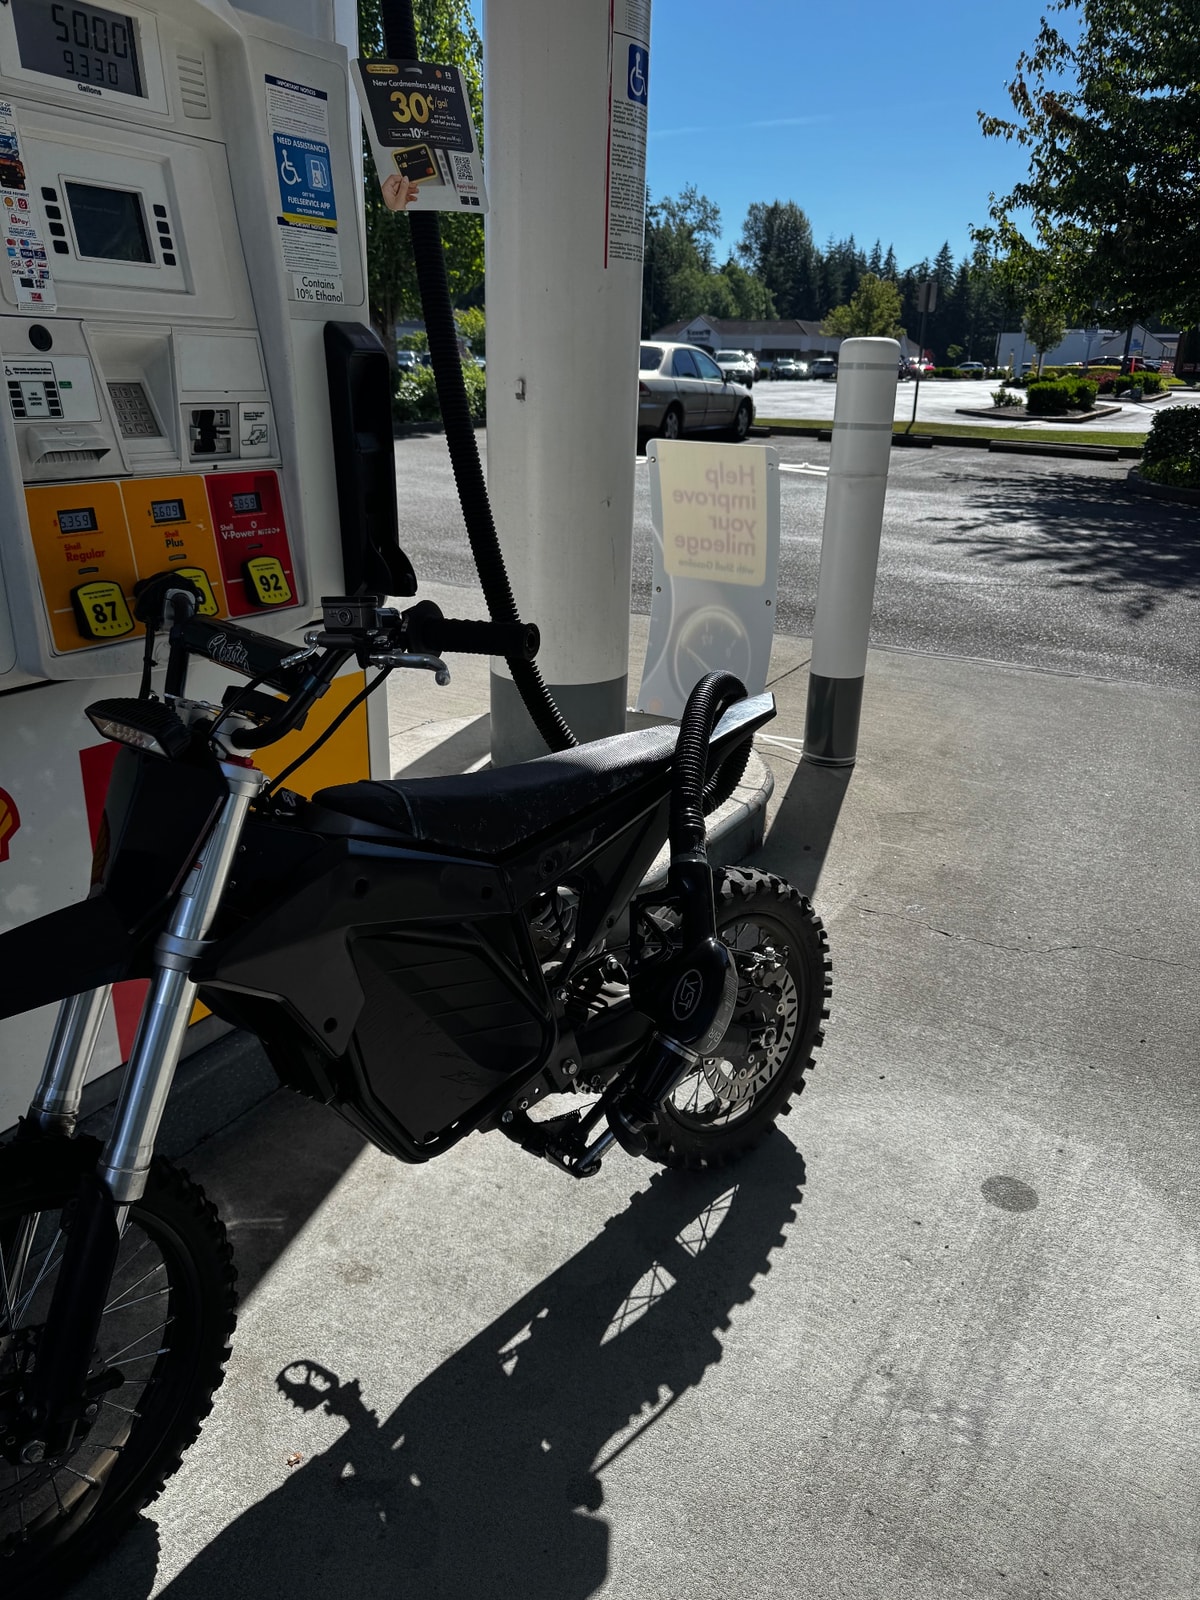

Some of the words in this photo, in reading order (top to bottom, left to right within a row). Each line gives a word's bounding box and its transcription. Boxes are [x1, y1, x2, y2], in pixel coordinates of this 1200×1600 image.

[51, 4, 128, 58] 50.00
[63, 50, 118, 85] 9.330
[77, 83, 102, 96] Gallons
[389, 80, 427, 89] Cardmembers
[428, 83, 441, 91] SAVE
[441, 85, 456, 93] MORE
[277, 136, 292, 145] NEED
[293, 140, 327, 154] ASSISTANCE?
[287, 196, 319, 208] FUELSERVICE
[302, 276, 335, 290] Contains
[296, 288, 313, 300] 10%
[316, 290, 343, 303] Ethanol
[164, 530, 179, 539] Shell
[221, 530, 255, 540] V-Power
[64, 542, 81, 551] Shell
[165, 538, 184, 549] Plus
[65, 548, 105, 563] Regular
[259, 573, 283, 593] 92
[92, 601, 117, 624] 87
